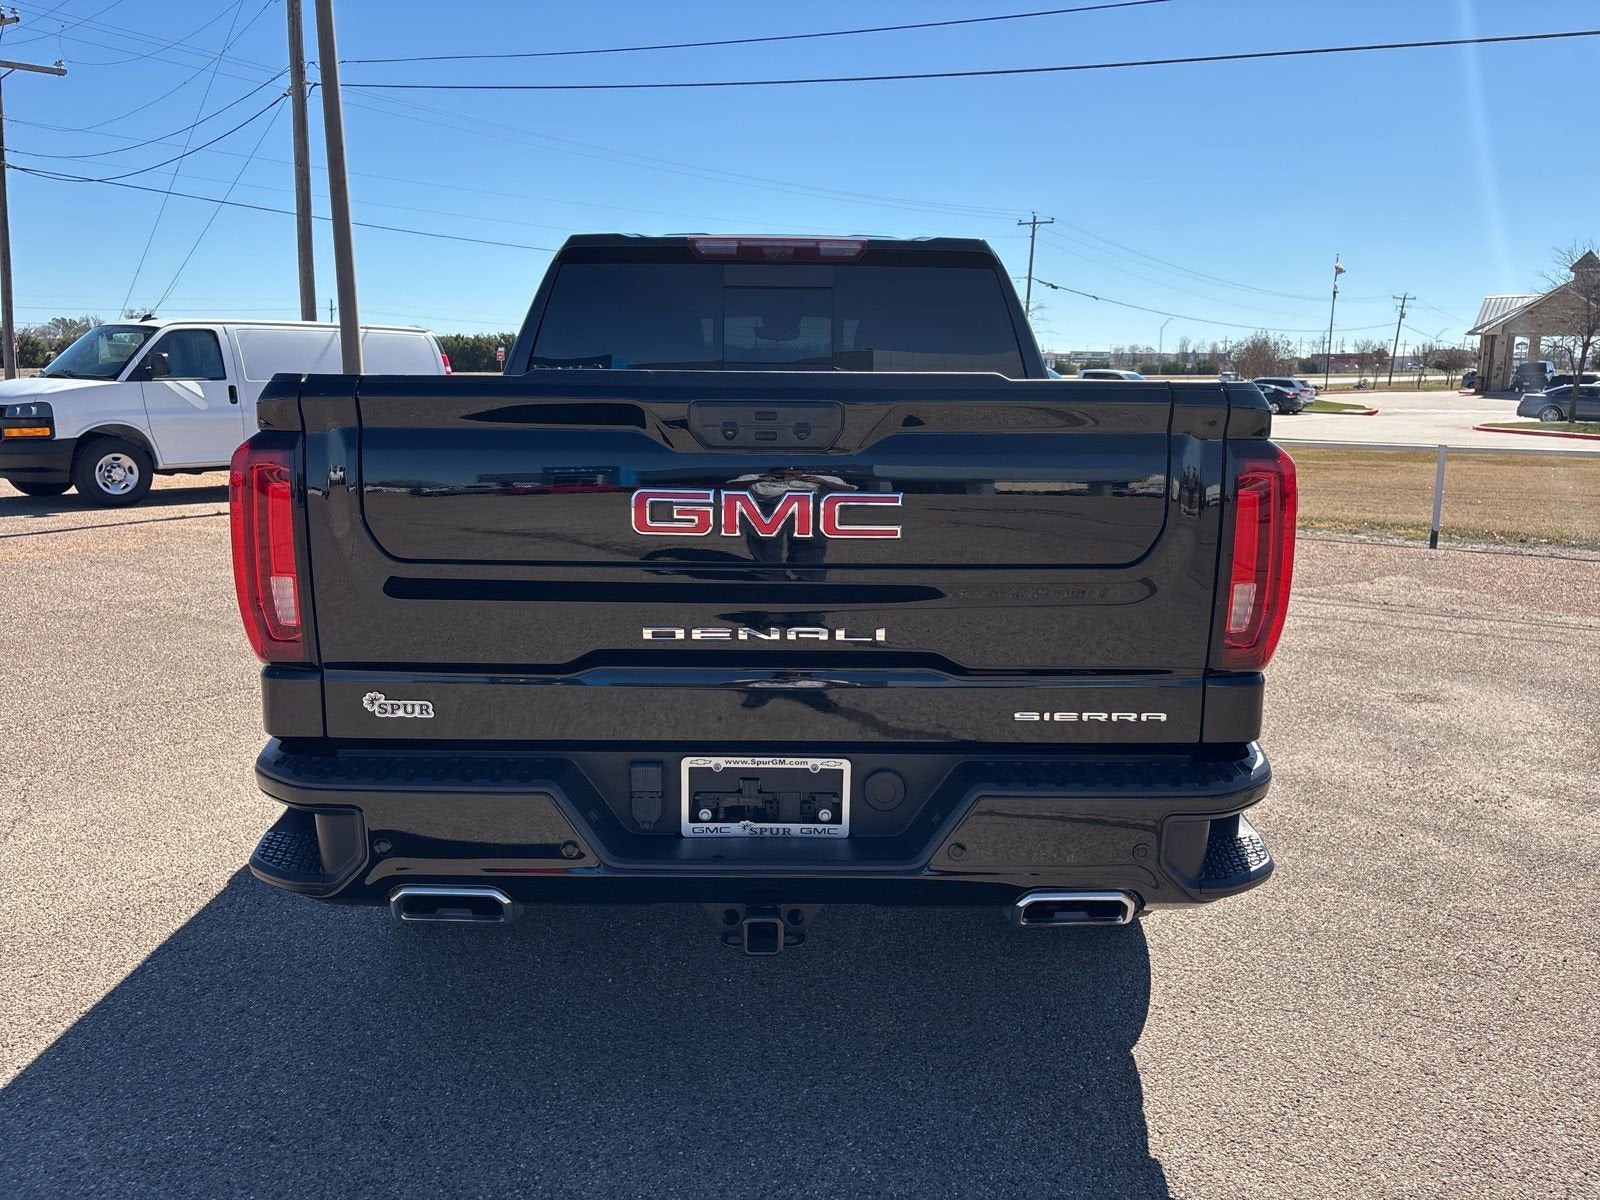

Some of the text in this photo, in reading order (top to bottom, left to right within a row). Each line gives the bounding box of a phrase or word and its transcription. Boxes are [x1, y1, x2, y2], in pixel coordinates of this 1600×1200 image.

[631, 488, 904, 540] GMC
[642, 627, 886, 641] DENALI
[378, 702, 431, 715] SPUR
[1013, 711, 1168, 722] SIERRA
[724, 758, 809, 767] www.SpurGM.com
[692, 826, 839, 836] GMC SPUR GMC
